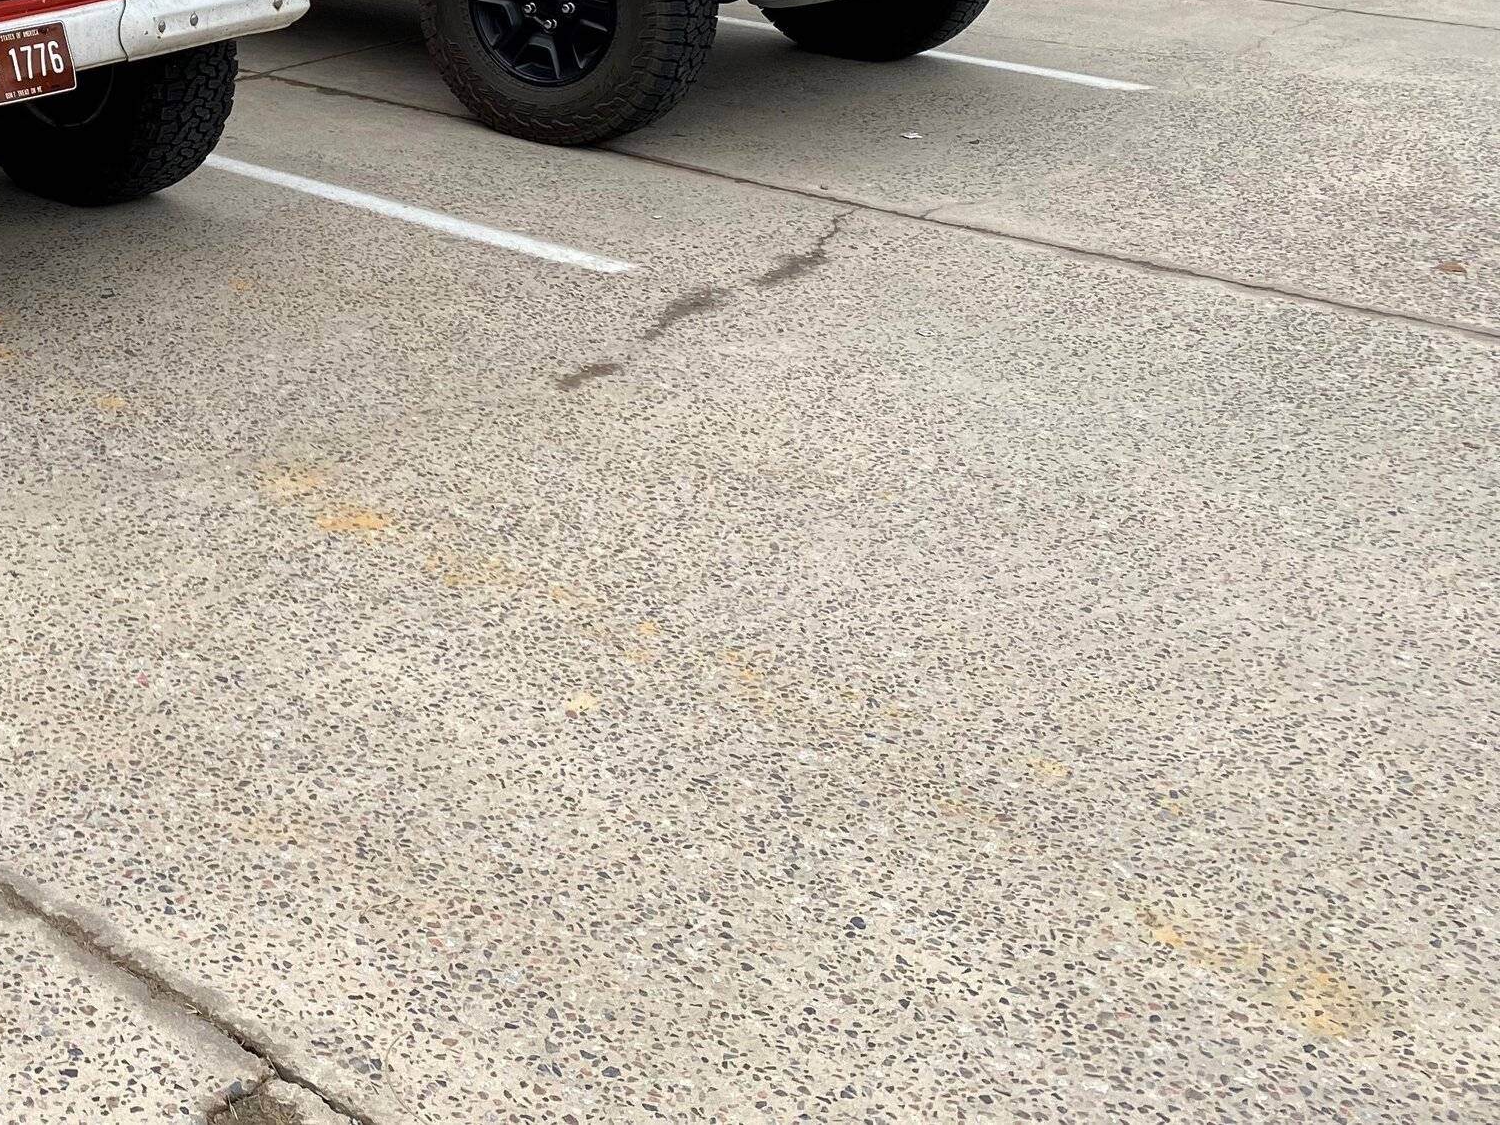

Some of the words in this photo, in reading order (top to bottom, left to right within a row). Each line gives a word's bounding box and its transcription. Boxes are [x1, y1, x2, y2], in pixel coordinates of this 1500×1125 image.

[0, 33, 15, 42] STATES
[15, 31, 21, 39] OF
[22, 29, 39, 38] AMERICA
[8, 40, 64, 82] 1776
